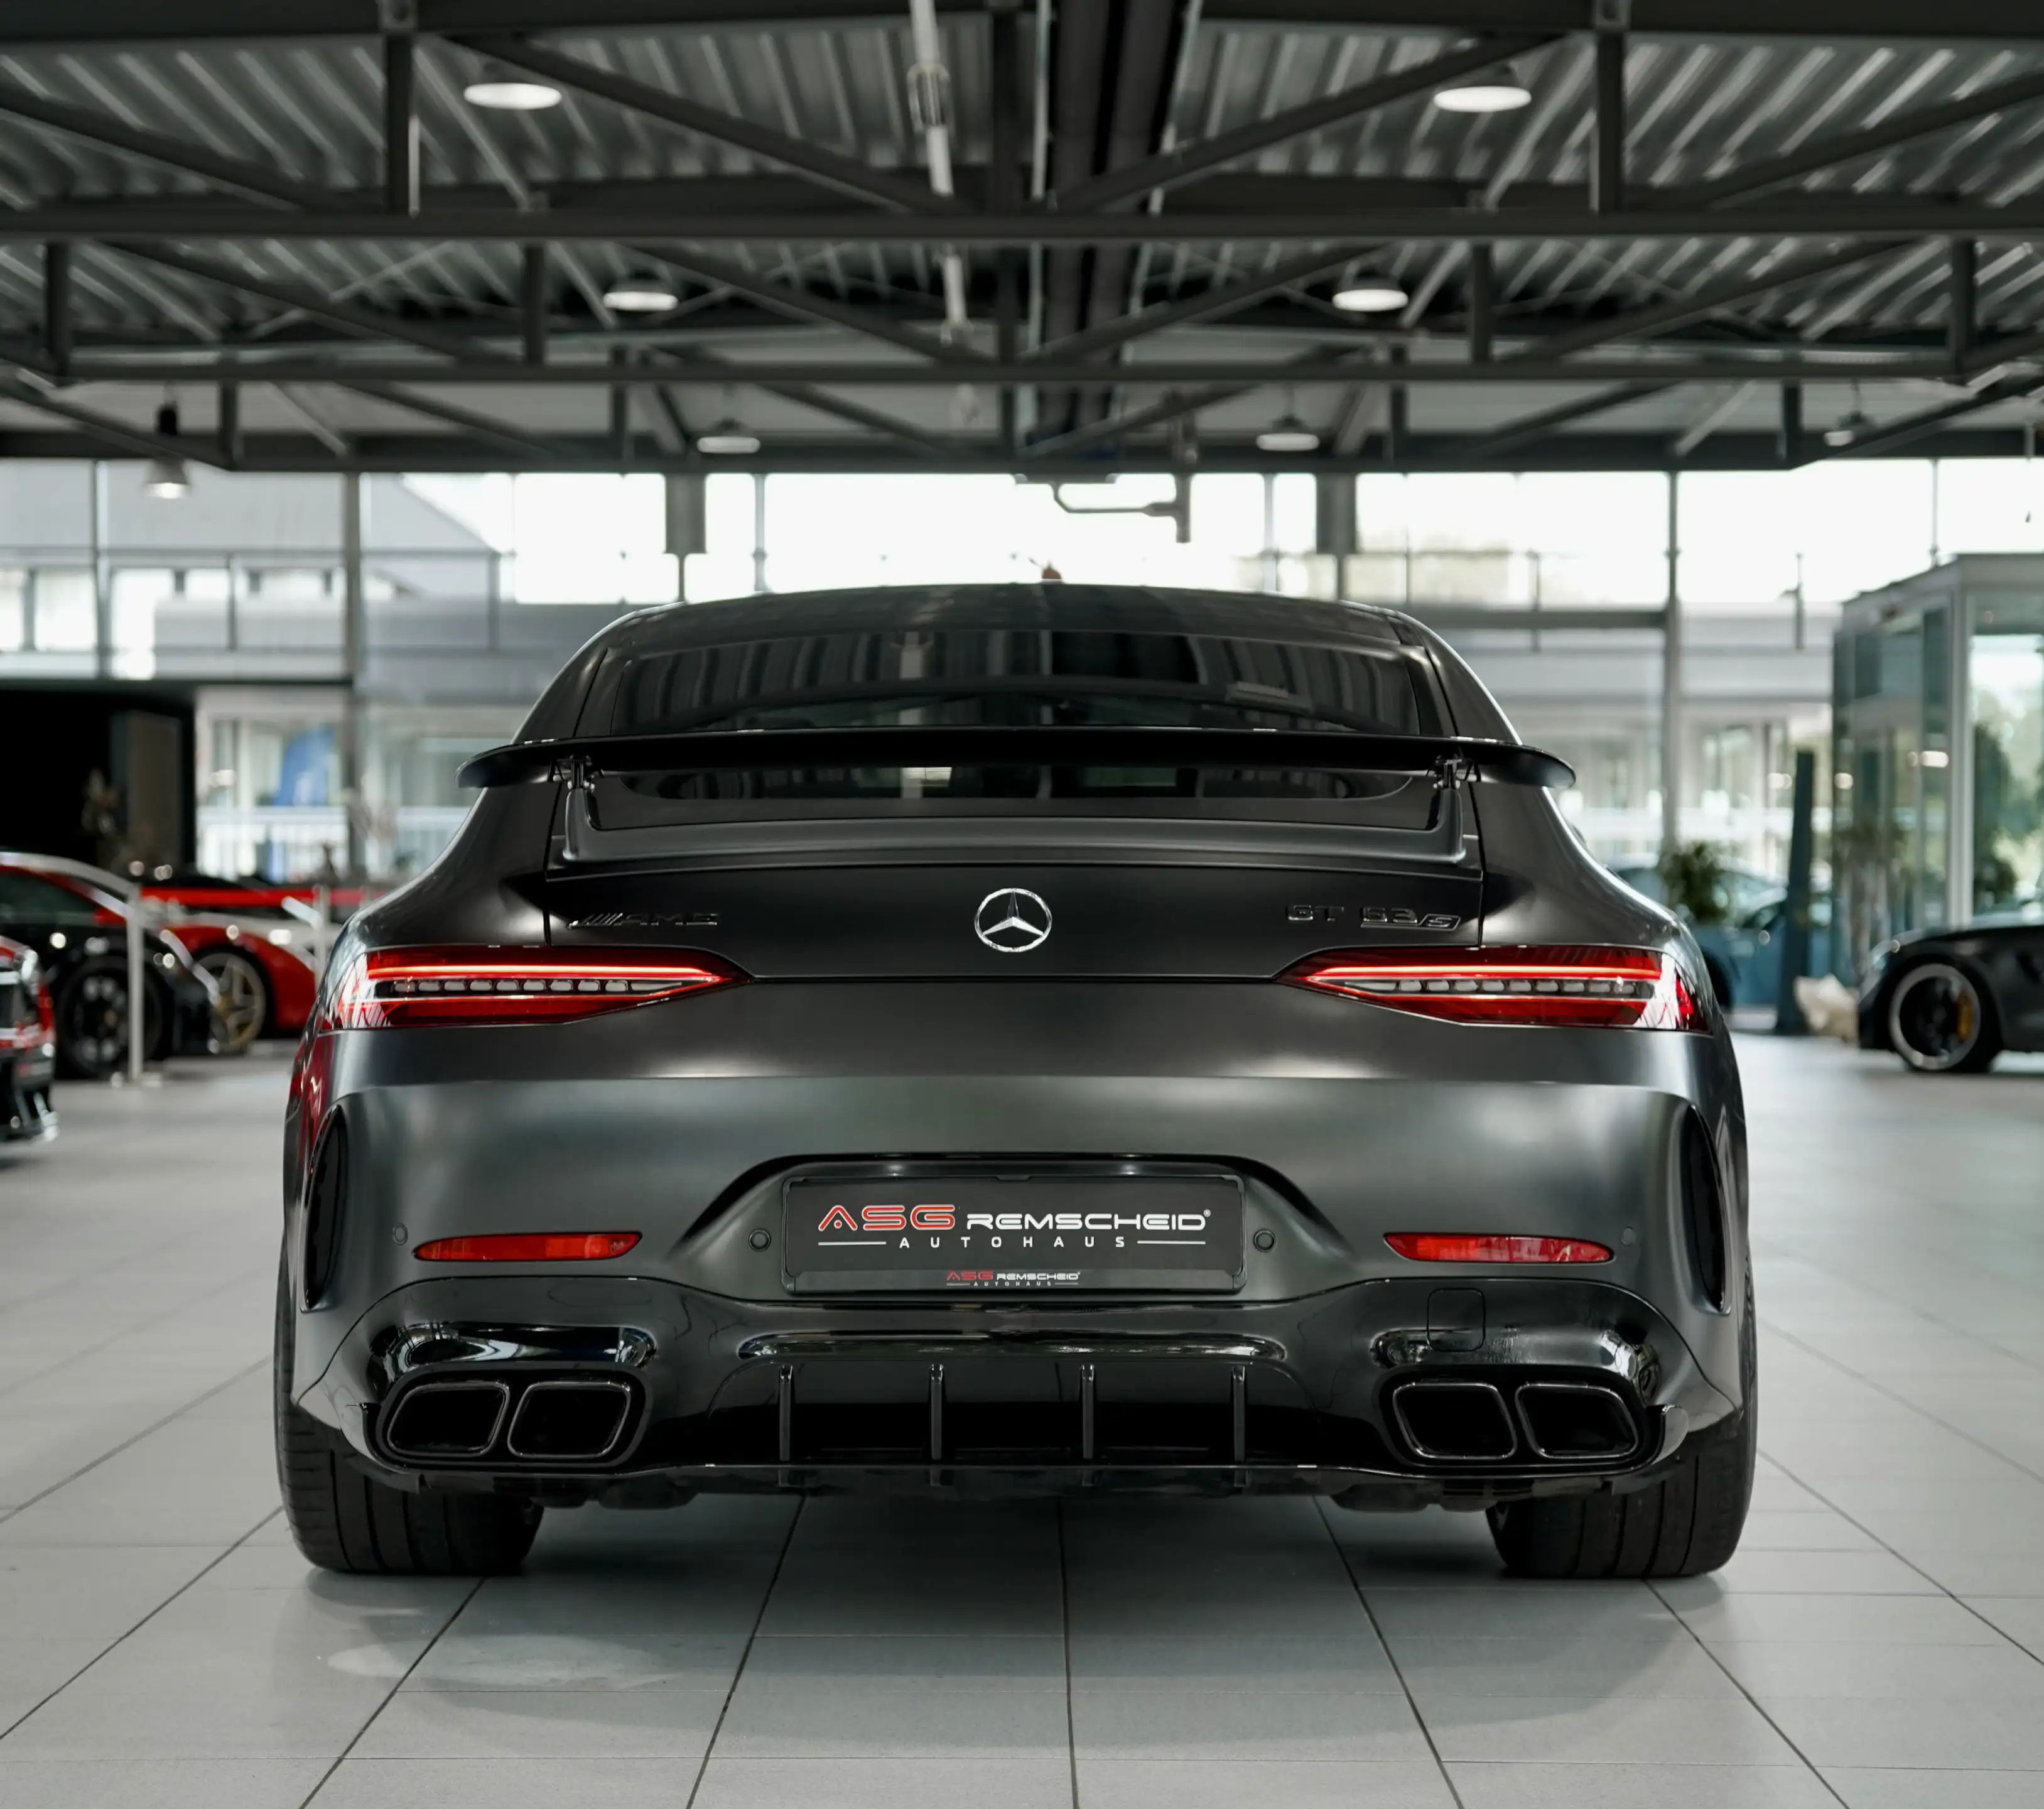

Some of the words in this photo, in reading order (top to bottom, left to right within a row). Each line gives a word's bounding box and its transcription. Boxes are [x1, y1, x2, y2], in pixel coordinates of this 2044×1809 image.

[612, 913, 718, 926] AMG
[1286, 905, 1344, 921] GT
[818, 1205, 956, 1232] ASG
[899, 1236, 1125, 1249] AUTOHAUS
[946, 1271, 993, 1281] ASG
